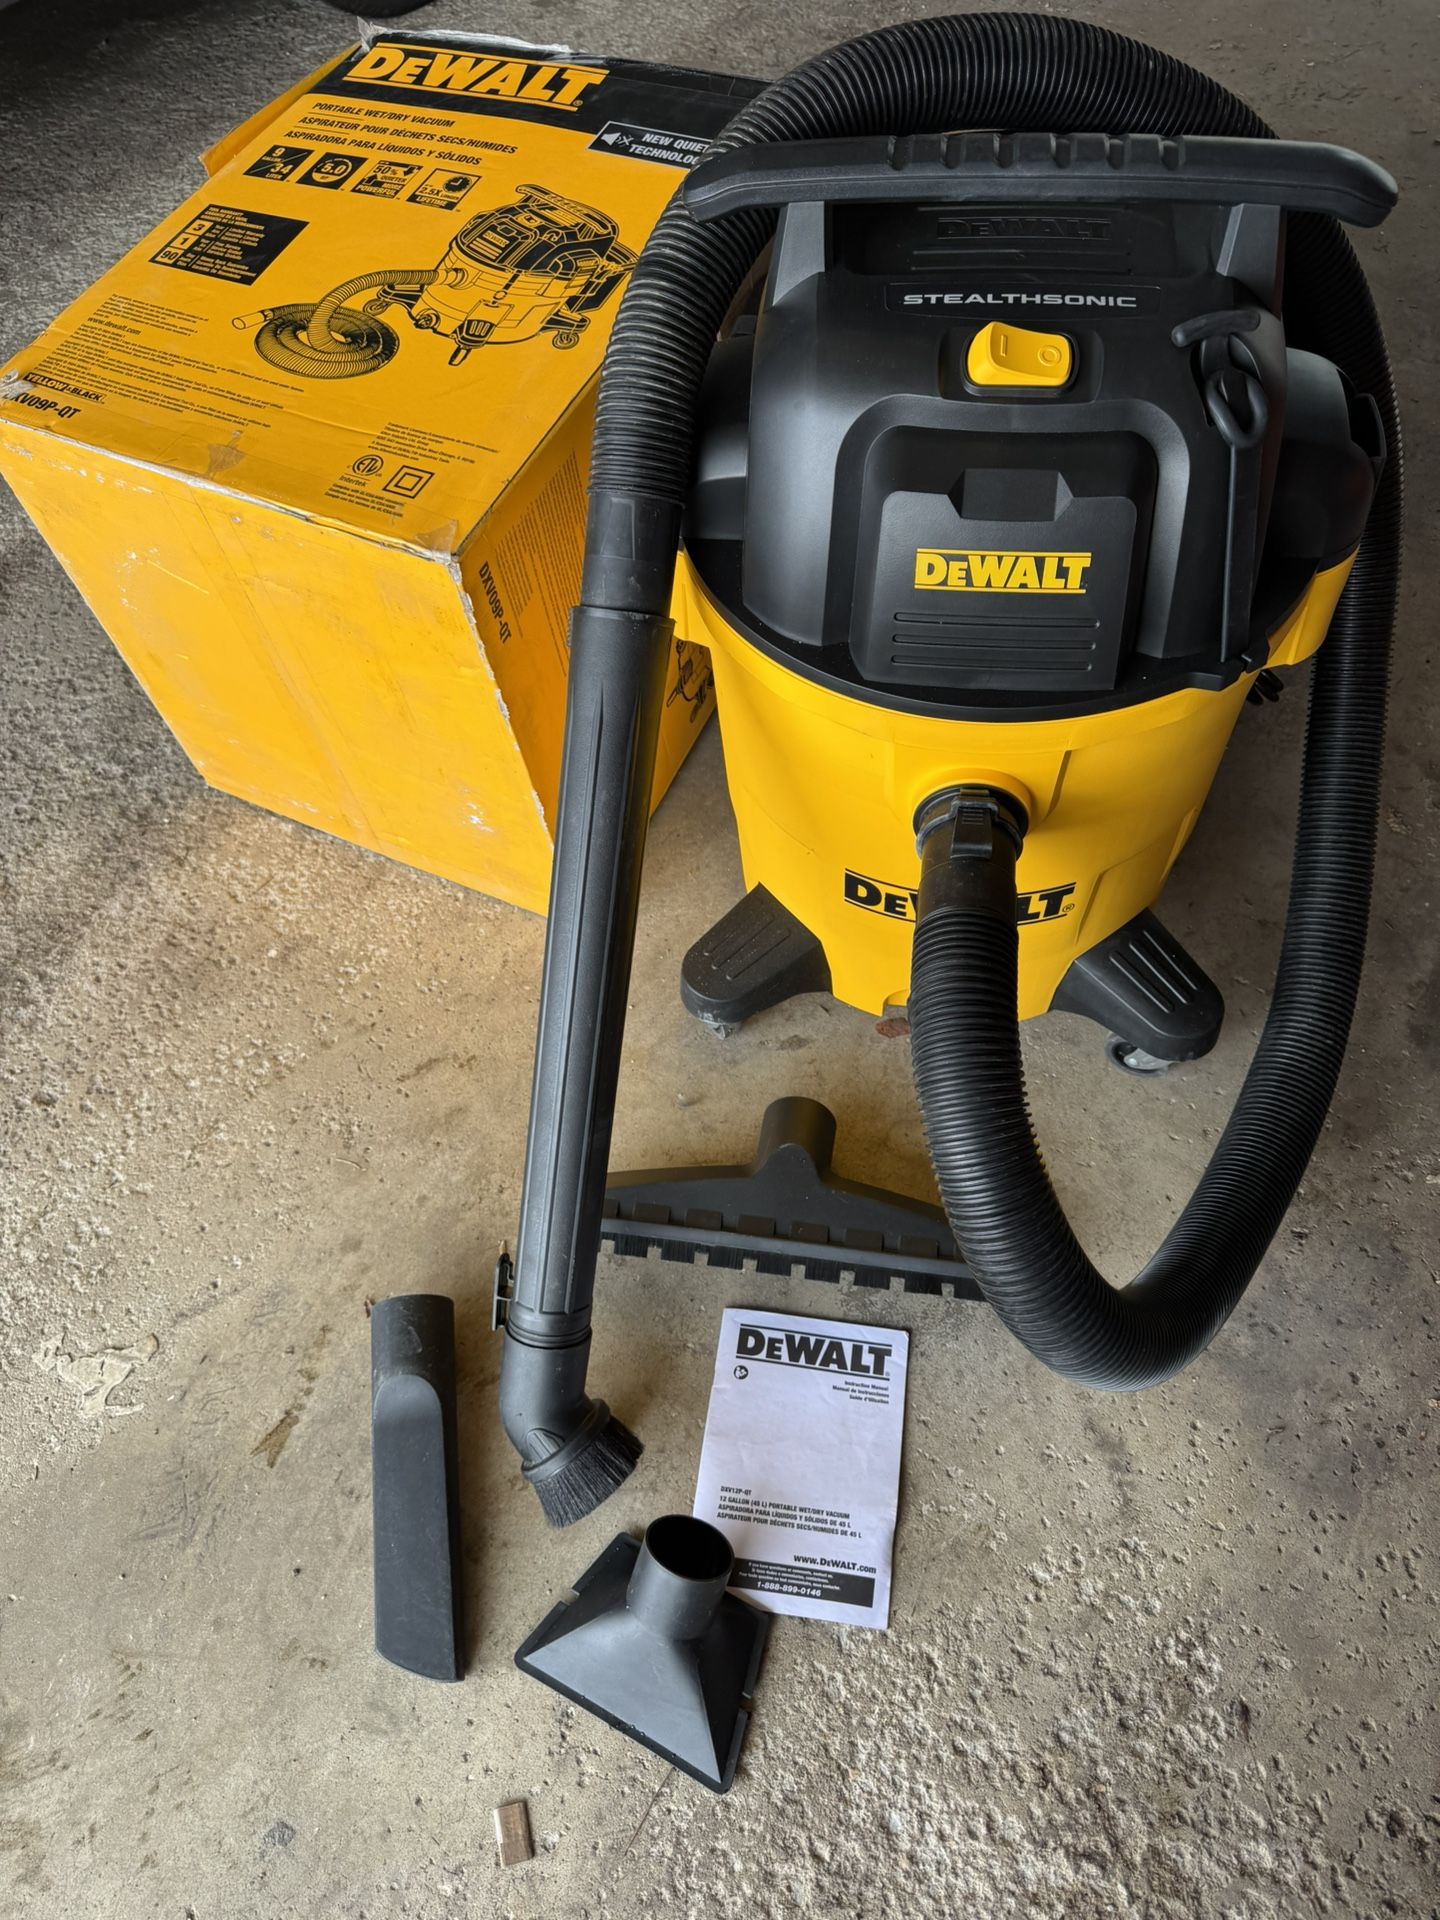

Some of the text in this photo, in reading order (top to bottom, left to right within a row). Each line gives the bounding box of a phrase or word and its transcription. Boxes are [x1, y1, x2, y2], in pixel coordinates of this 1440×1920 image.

[312, 103, 455, 127] PORTABLE WET/DRY VACUUM
[298, 116, 518, 154] ASPIRATEUR POUR DÉCHETS SECS/HUMIDES
[642, 133, 674, 147] NEW
[272, 147, 286, 157] 9
[284, 130, 482, 165] ASPIRADORA PARA LÍQUIDOS Y SÓLIDOS
[629, 143, 699, 165] TECHNOLO
[270, 162, 293, 174] 34
[321, 162, 347, 175] 5.0
[355, 185, 396, 196] POWERFUL
[419, 186, 442, 197] 2.5X
[193, 223, 206, 231] 3
[179, 237, 188, 245] 1
[161, 250, 179, 261] 90
[904, 293, 1137, 308] STEALTHSONIC
[3, 391, 82, 418] XV09P-QT
[339, 475, 367, 487] Intertek
[480, 560, 511, 644] DXV09P-QT
[844, 872, 1076, 917] DELT
[720, 1485, 752, 1496] DXV12P-QT
[718, 1503, 754, 1515] ASPIRADORA
[755, 1508, 771, 1517] PARA
[771, 1510, 798, 1521] LÍQUIDOS
[804, 1514, 829, 1525] SÓLIDOS
[829, 1519, 837, 1527] DE
[839, 1520, 847, 1528] 45
[728, 1497, 750, 1506] GALLON
[768, 1502, 797, 1512] PORTABLE
[798, 1506, 825, 1516] WET/DRY
[825, 1510, 850, 1520] VACUUM
[717, 1511, 751, 1522] ASPIRATEUR
[752, 1516, 769, 1525] POUR
[769, 1518, 795, 1529] DÉCHETS
[796, 1522, 839, 1535] SECS/HUMIDES
[840, 1528, 848, 1536] DE
[757, 1581, 821, 1597] 1-888-899-0146
